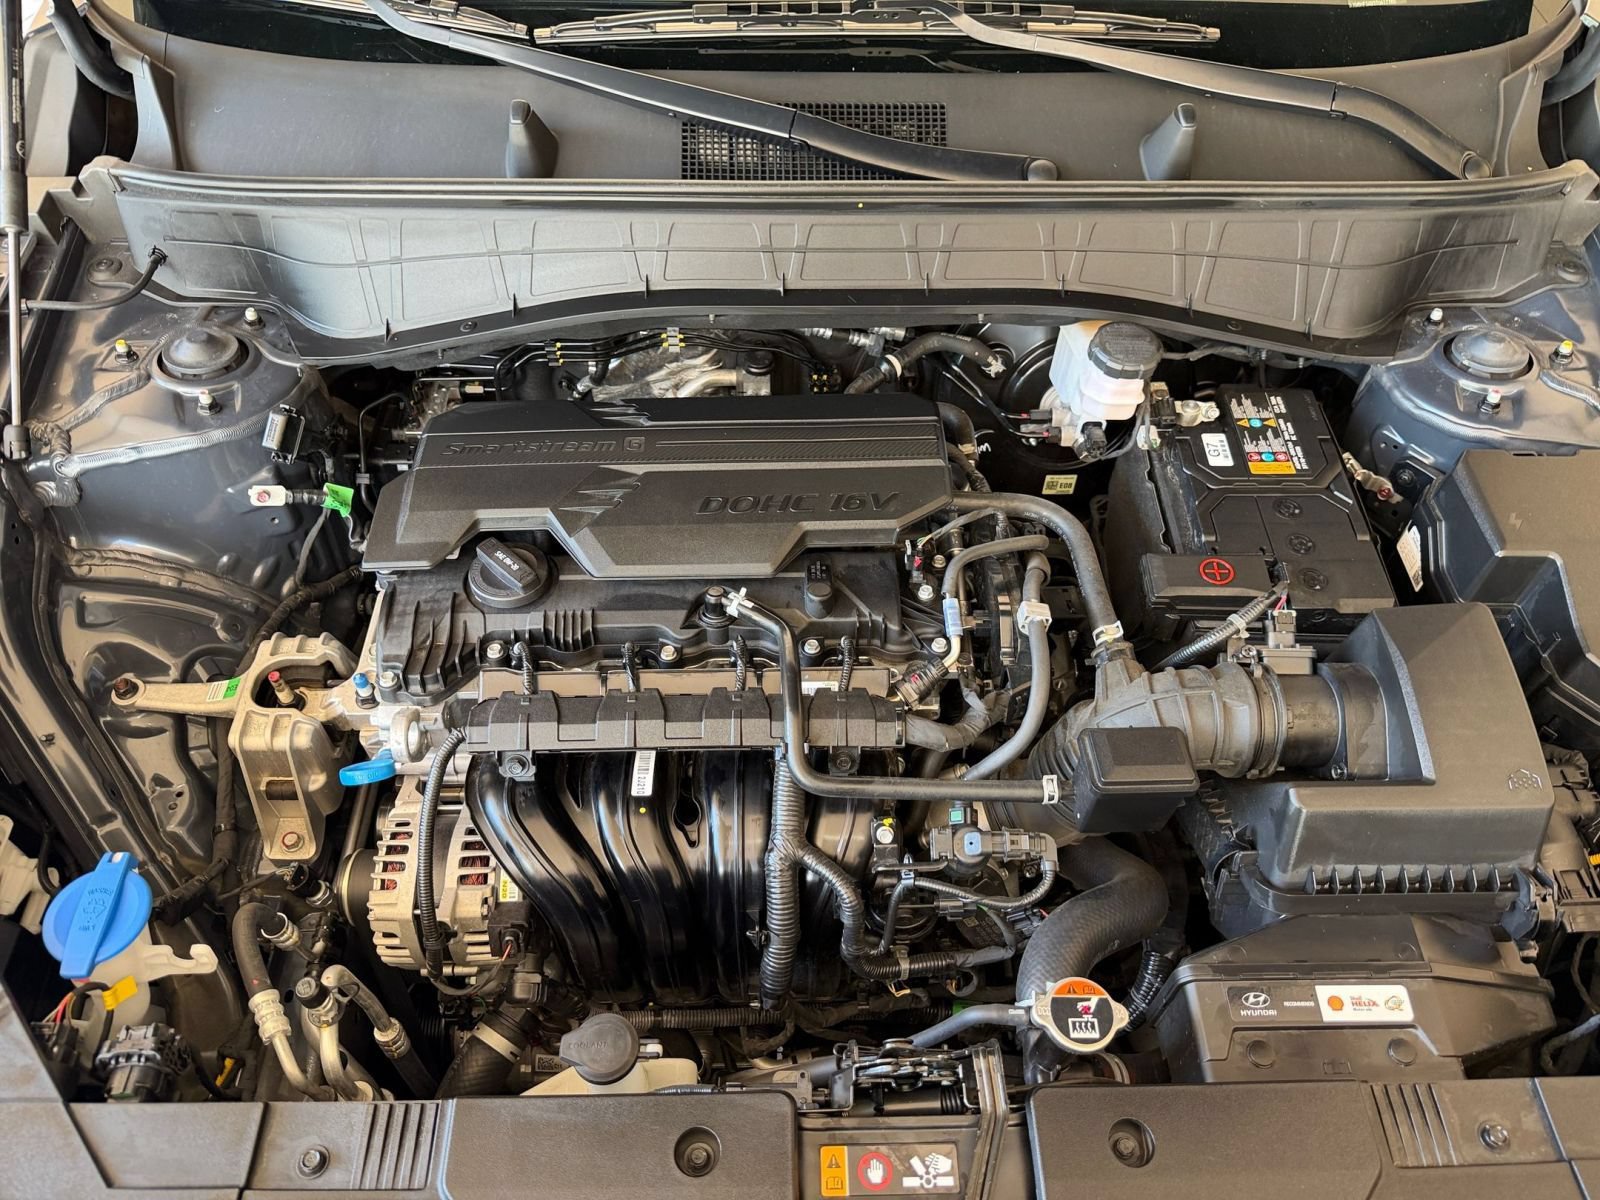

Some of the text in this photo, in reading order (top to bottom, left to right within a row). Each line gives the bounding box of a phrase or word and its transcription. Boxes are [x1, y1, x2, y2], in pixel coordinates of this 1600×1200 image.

[440, 440, 617, 455] Smartstream
[1206, 442, 1221, 457] G7
[696, 491, 900, 515] DOHC 16V
[494, 550, 506, 561] SAE
[1240, 1009, 1278, 1017] HYUNDAI
[568, 1041, 608, 1049] COOLANT
